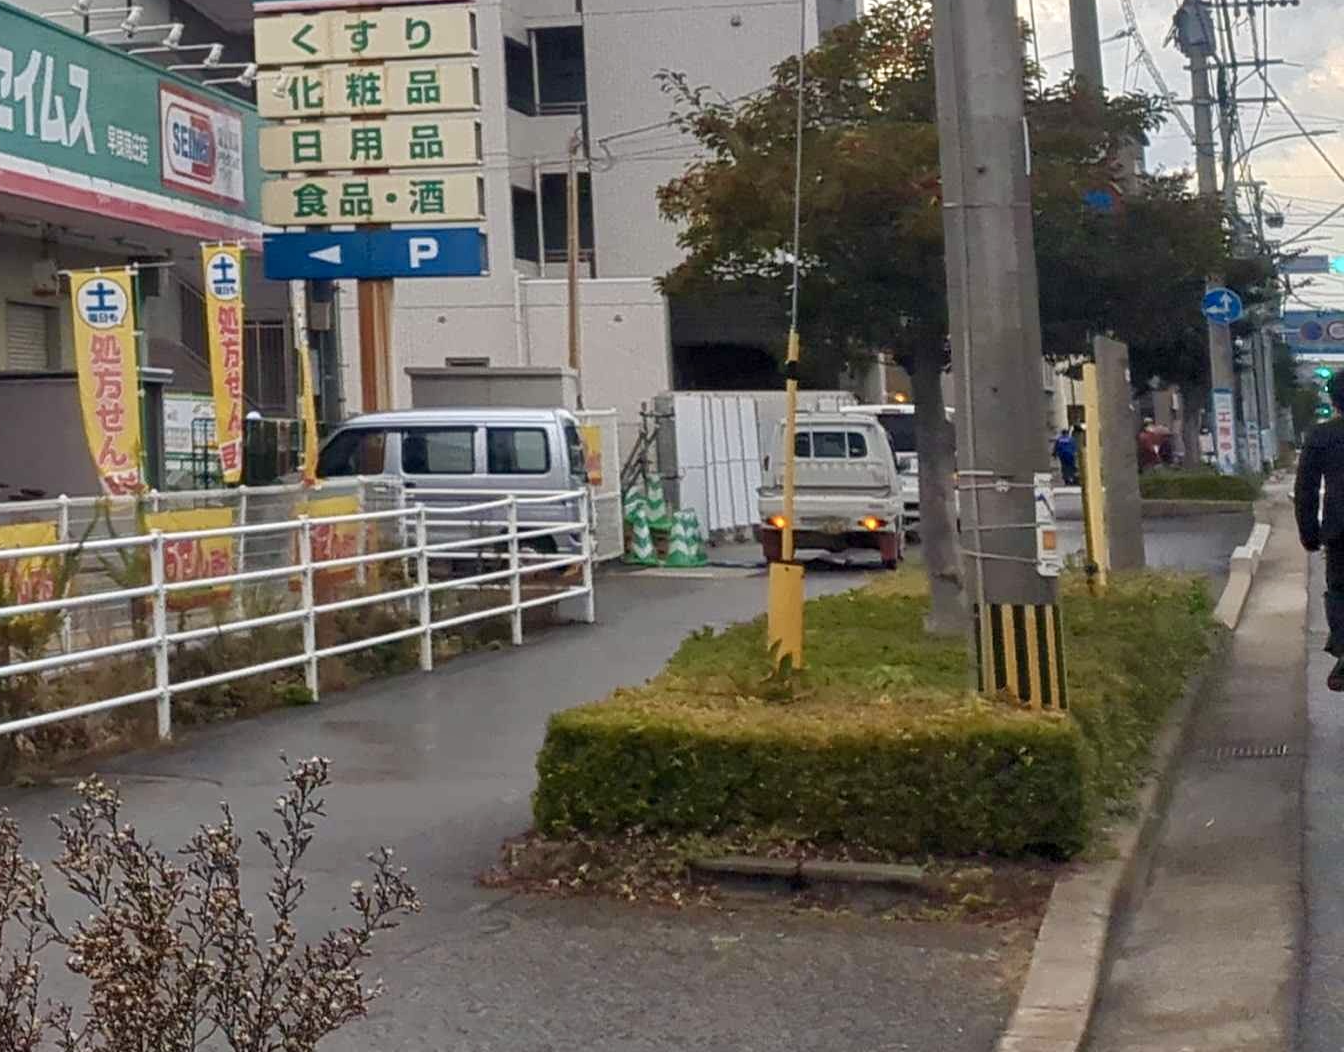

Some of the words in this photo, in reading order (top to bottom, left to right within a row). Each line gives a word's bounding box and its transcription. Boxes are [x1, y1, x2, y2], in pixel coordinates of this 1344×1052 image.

[291, 18, 432, 56] くすり
[287, 71, 441, 111] 化粧品
[292, 125, 445, 163] 日用品
[293, 180, 446, 218] 食品・酒
[409, 237, 440, 268] P
[90, 333, 128, 467] 処方せん
